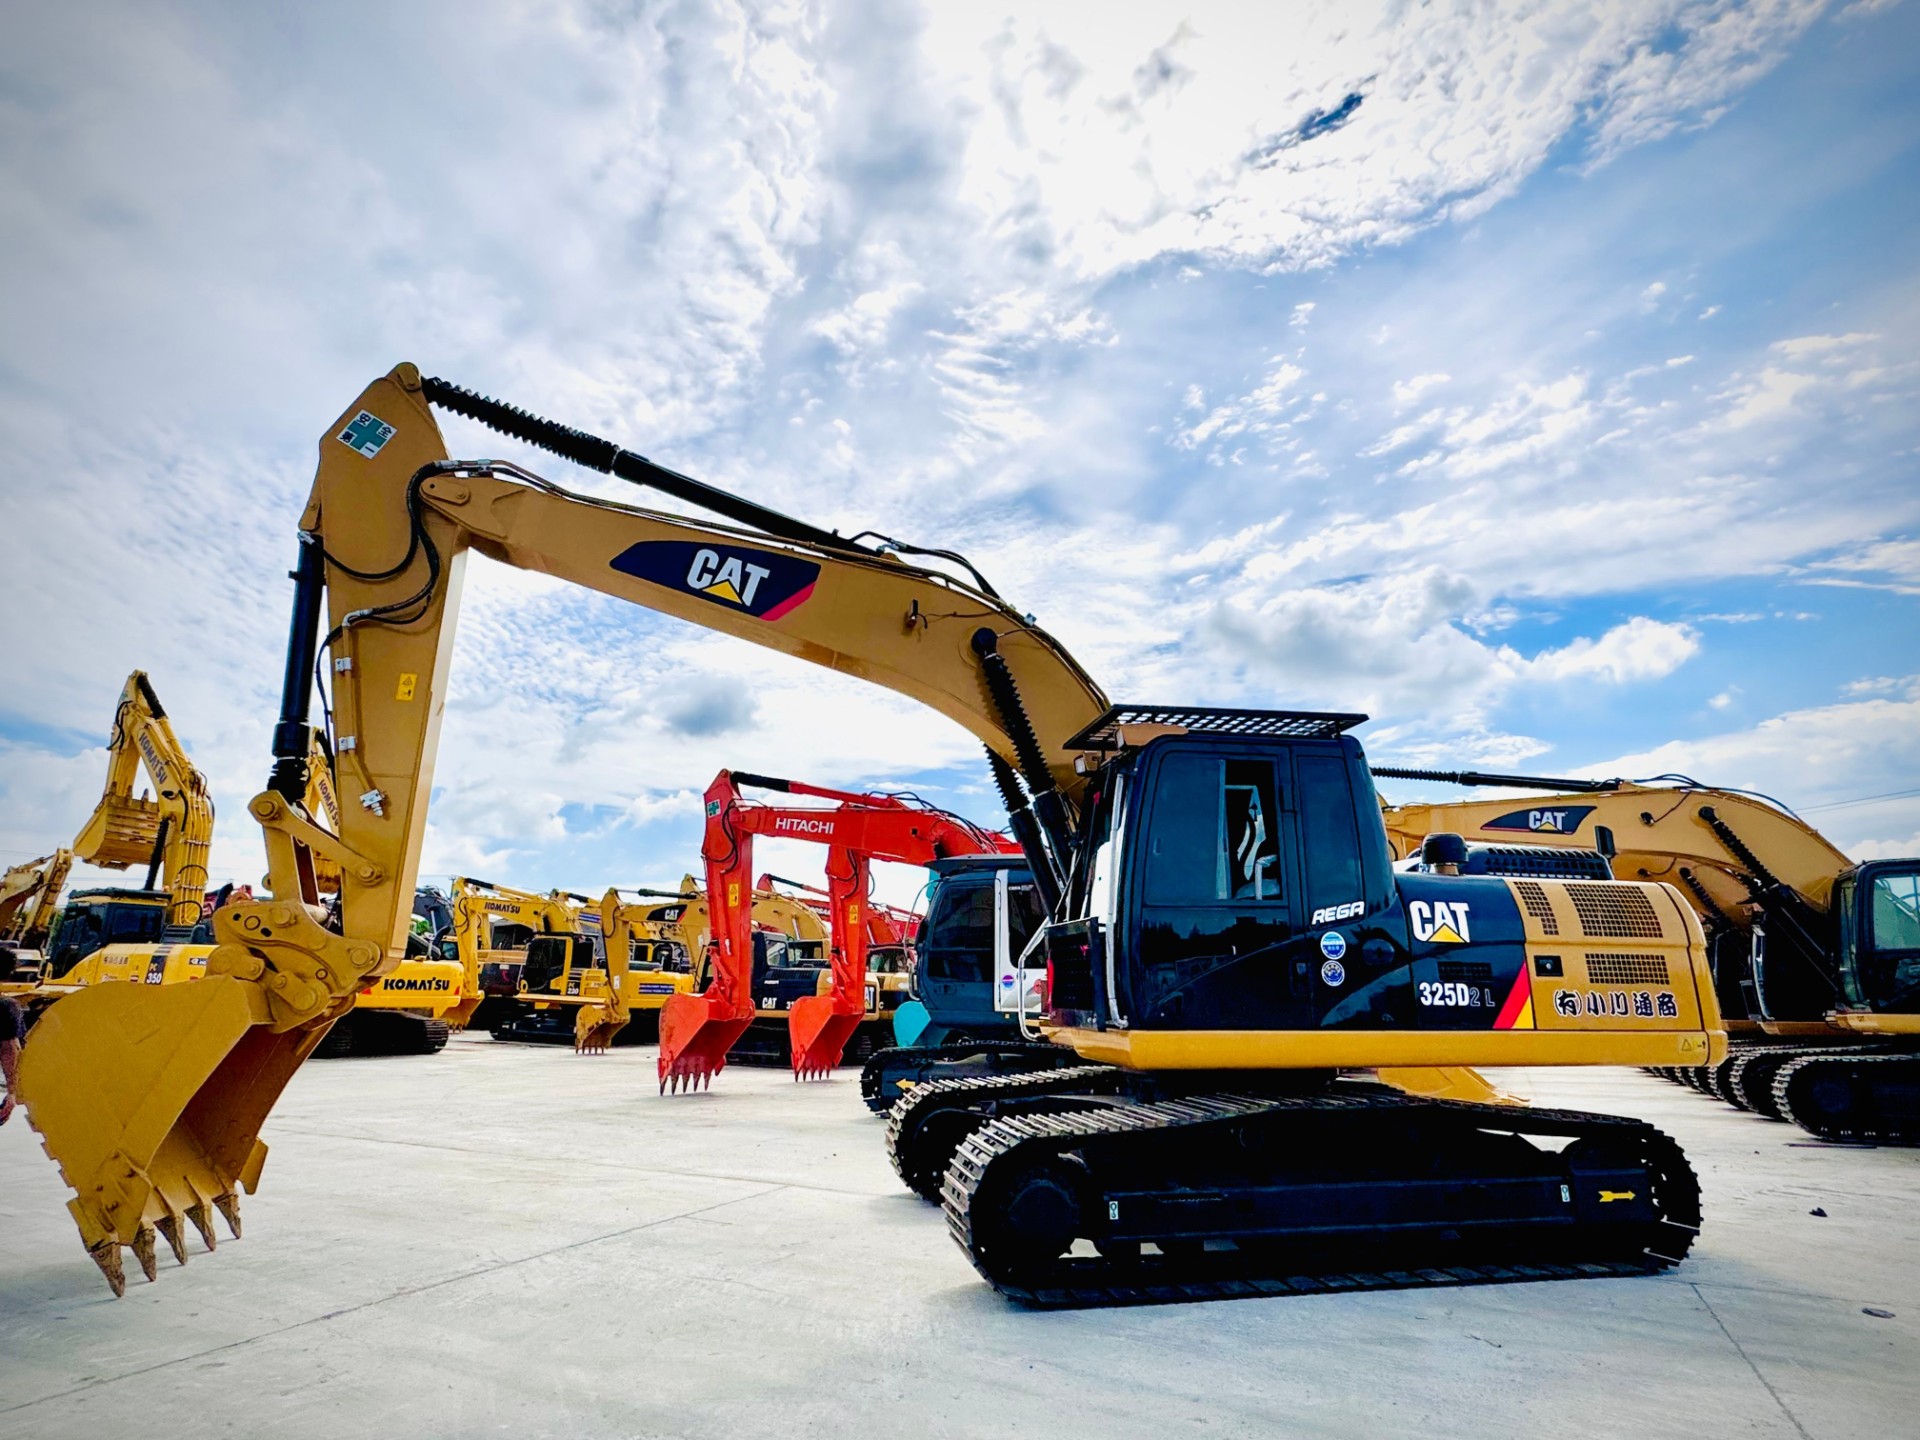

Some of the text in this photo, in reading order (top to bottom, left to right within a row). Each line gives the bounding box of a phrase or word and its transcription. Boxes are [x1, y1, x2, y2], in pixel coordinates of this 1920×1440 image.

[687, 548, 771, 607] CAT
[139, 731, 168, 785] KOMATSU
[775, 817, 835, 835] HITACHI
[1528, 811, 1567, 831] CAT
[484, 902, 521, 914] KOMATSU
[664, 909, 679, 920] CAT
[1311, 901, 1365, 925] REGA
[1409, 900, 1471, 943] CAT
[146, 972, 162, 983] 350
[383, 976, 450, 991] KOMATSU
[762, 997, 777, 1009] CAT
[864, 986, 875, 1009] AT
[1485, 989, 1496, 1007] L
